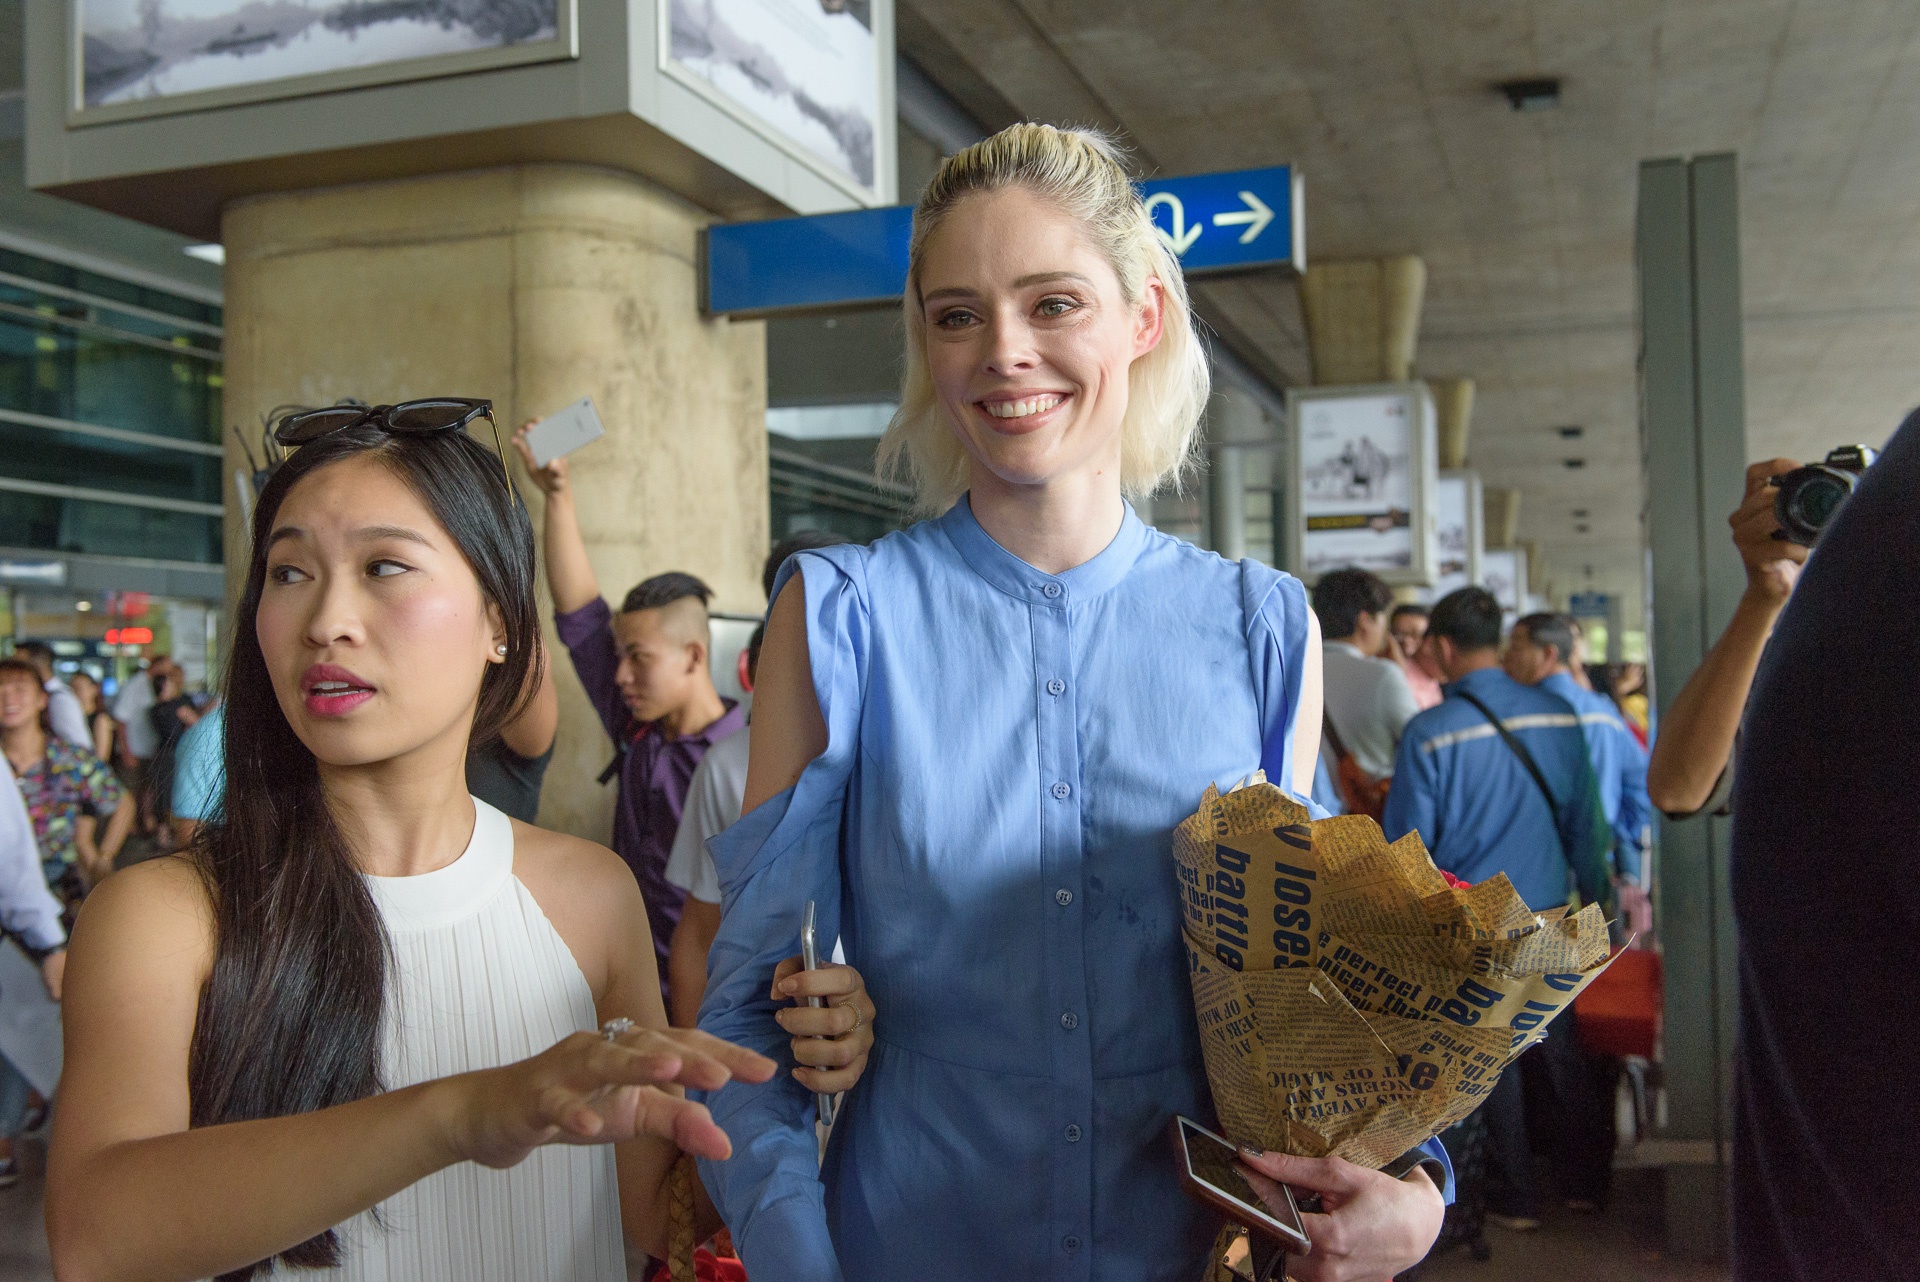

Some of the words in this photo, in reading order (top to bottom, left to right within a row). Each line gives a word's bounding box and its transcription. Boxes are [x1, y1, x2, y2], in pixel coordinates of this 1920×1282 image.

[1216, 844, 1251, 971] battle
[1317, 955, 1379, 998] nicer
[1333, 945, 1423, 1002] perfect
[1223, 999, 1241, 1019] OF
[1430, 1030, 1474, 1057] price
[1472, 1052, 1498, 1069] the
[1266, 1070, 1334, 1089] MAGIC
[1342, 1067, 1373, 1081] OF
[1285, 1085, 1326, 1105] AND
